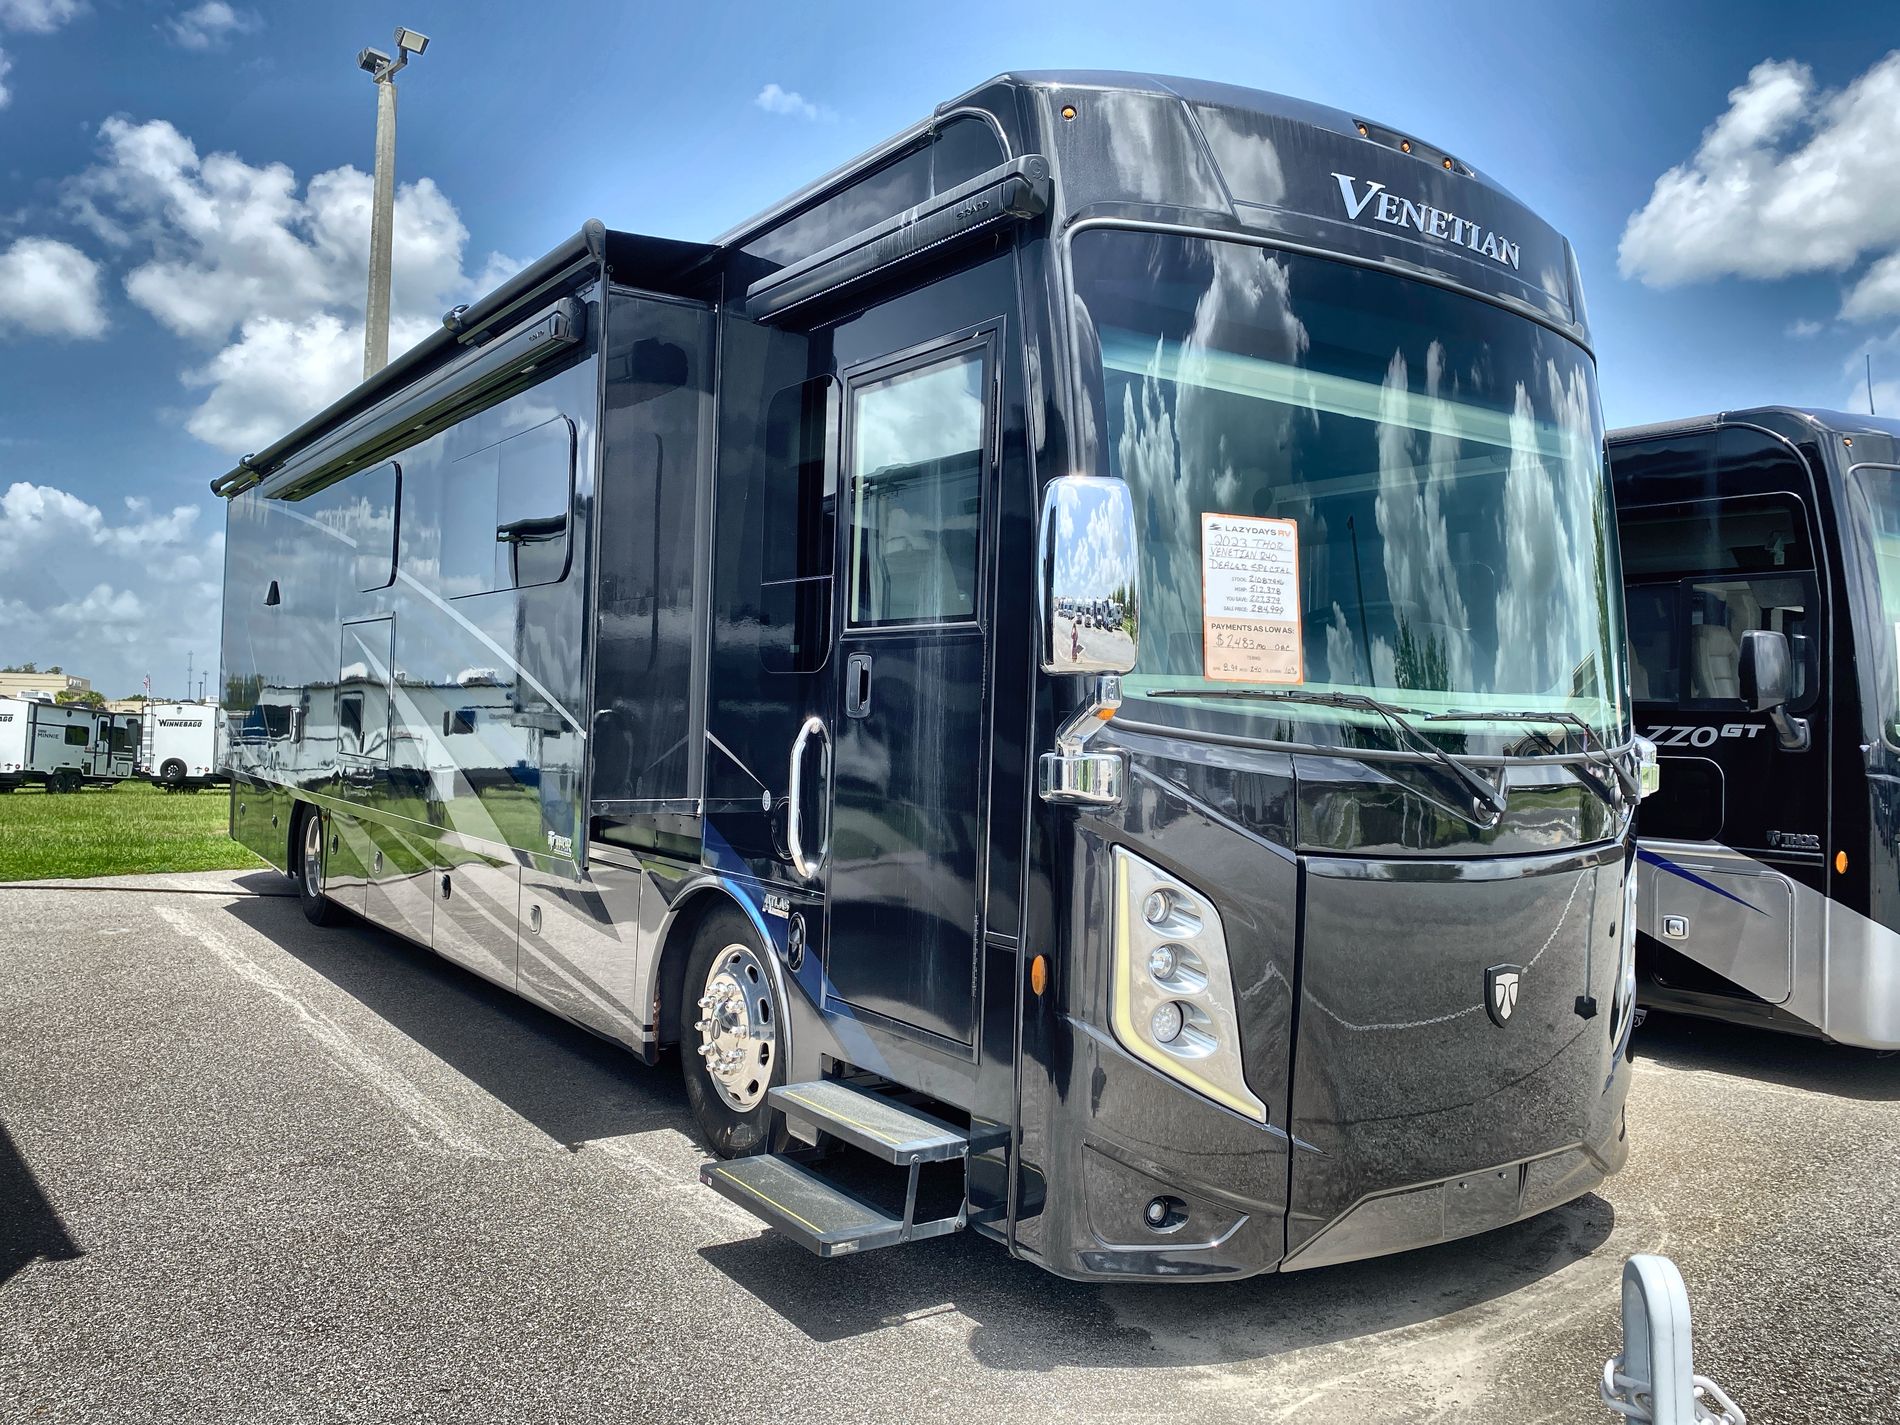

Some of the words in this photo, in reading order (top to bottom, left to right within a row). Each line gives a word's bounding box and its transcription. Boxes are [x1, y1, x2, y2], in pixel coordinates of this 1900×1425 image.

[1330, 172, 1521, 271] VENETIAN
[1225, 525, 1277, 536] LAZYDAYS
[1278, 529, 1291, 537] RV
[1214, 534, 1247, 547] 2023
[1252, 539, 1284, 550] THOR
[1210, 546, 1257, 560] VENETIAN
[1250, 563, 1290, 575] SPECIAL
[1211, 623, 1253, 632] PAYMENTS
[1264, 626, 1282, 634] LOW
[1282, 627, 1295, 635] AS:
[157, 718, 203, 728] WINNEBAGO
[1720, 723, 1767, 738] GT
[1781, 832, 1820, 847] THOR
